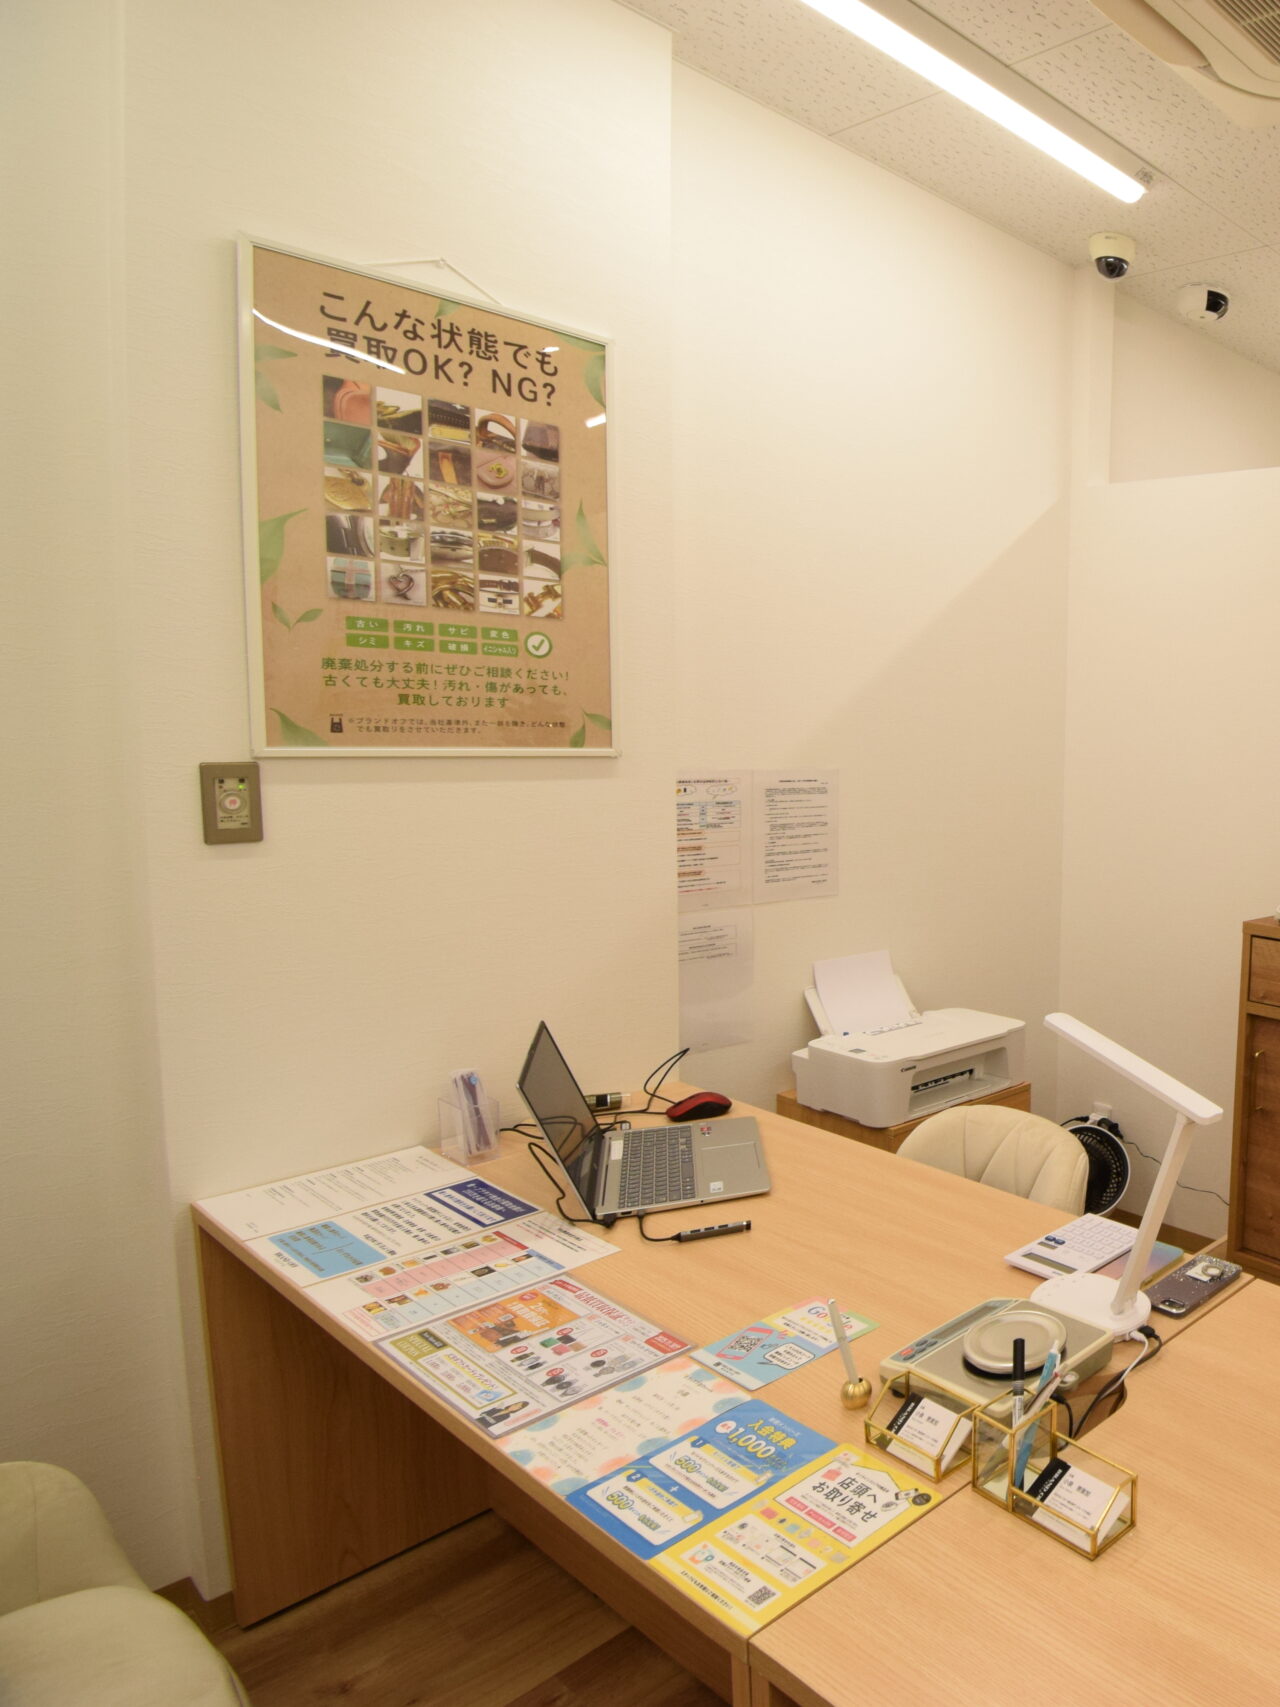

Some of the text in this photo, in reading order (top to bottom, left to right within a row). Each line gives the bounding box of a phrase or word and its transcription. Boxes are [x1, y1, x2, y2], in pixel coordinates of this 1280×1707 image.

[320, 291, 558, 377] こんな状態でも
[490, 368, 556, 407] NG?
[403, 623, 425, 633] 汚れ
[448, 626, 469, 636] サビ
[358, 637, 377, 646] シミ
[403, 640, 425, 649] キズ
[321, 657, 569, 682] 廃棄処分する前にぜひご相談ください！
[396, 693, 510, 709] 買取しております
[837, 1476, 877, 1504] 店頭へ
[811, 1480, 878, 1523] お取り寄せ
